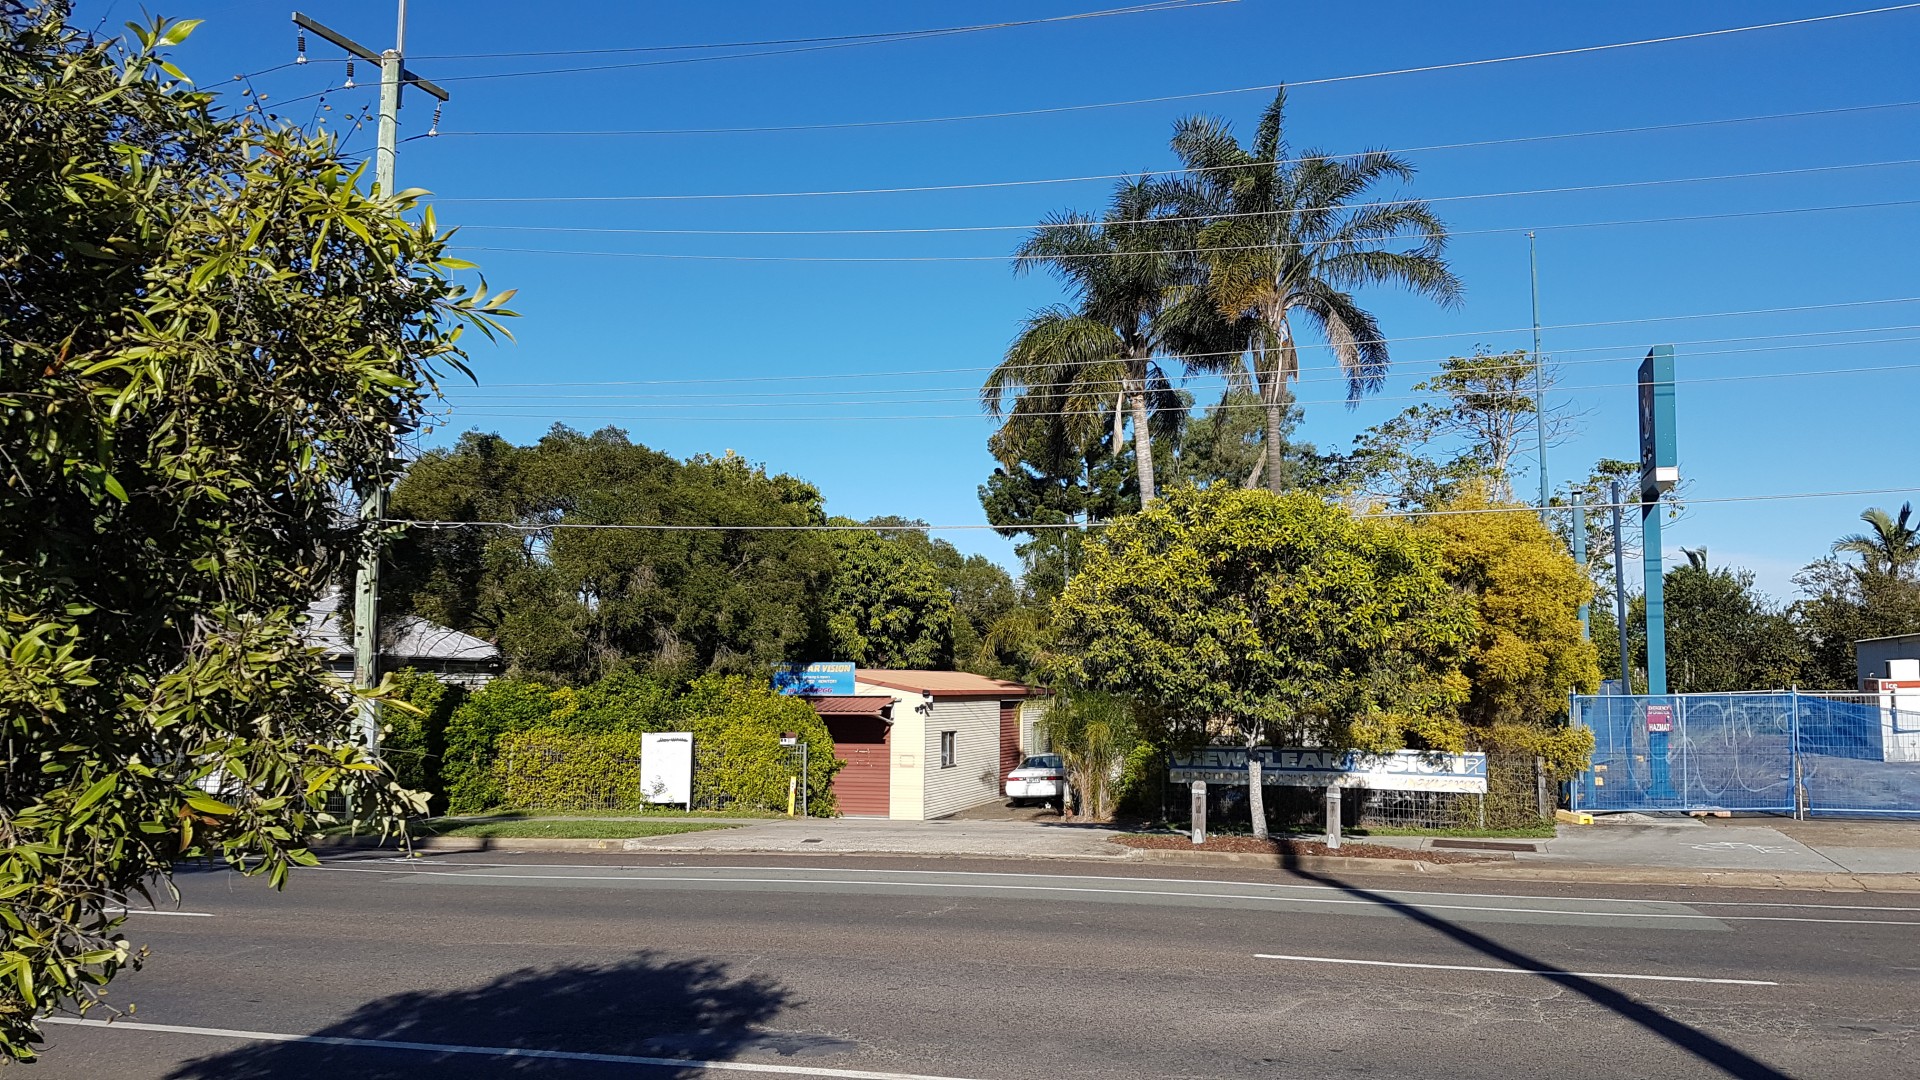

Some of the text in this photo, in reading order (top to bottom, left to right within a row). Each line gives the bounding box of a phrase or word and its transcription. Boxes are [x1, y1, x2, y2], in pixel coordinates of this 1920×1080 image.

[822, 665, 851, 673] VISION
[1885, 681, 1898, 689] ice
[1648, 723, 1671, 732] HAZMAT
